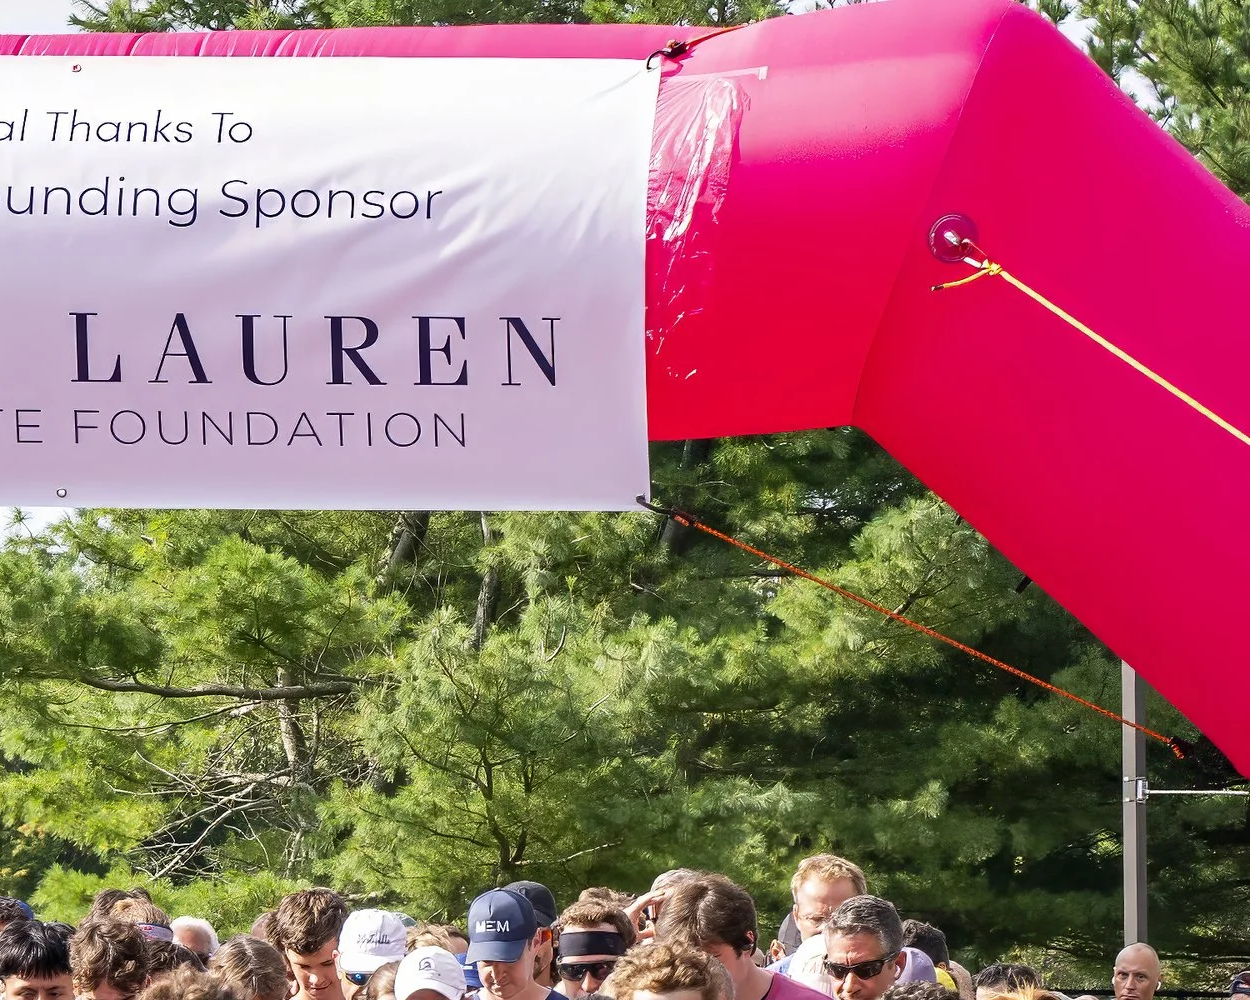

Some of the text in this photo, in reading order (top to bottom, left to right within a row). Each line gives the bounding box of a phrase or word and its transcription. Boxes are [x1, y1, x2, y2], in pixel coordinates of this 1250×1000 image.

[46, 109, 194, 143] Thanks
[211, 112, 253, 143] To
[219, 179, 443, 228] Sponsor
[68, 312, 561, 387] LAUREN
[73, 410, 467, 448] FOUNDATION
[475, 920, 510, 933] MEM
